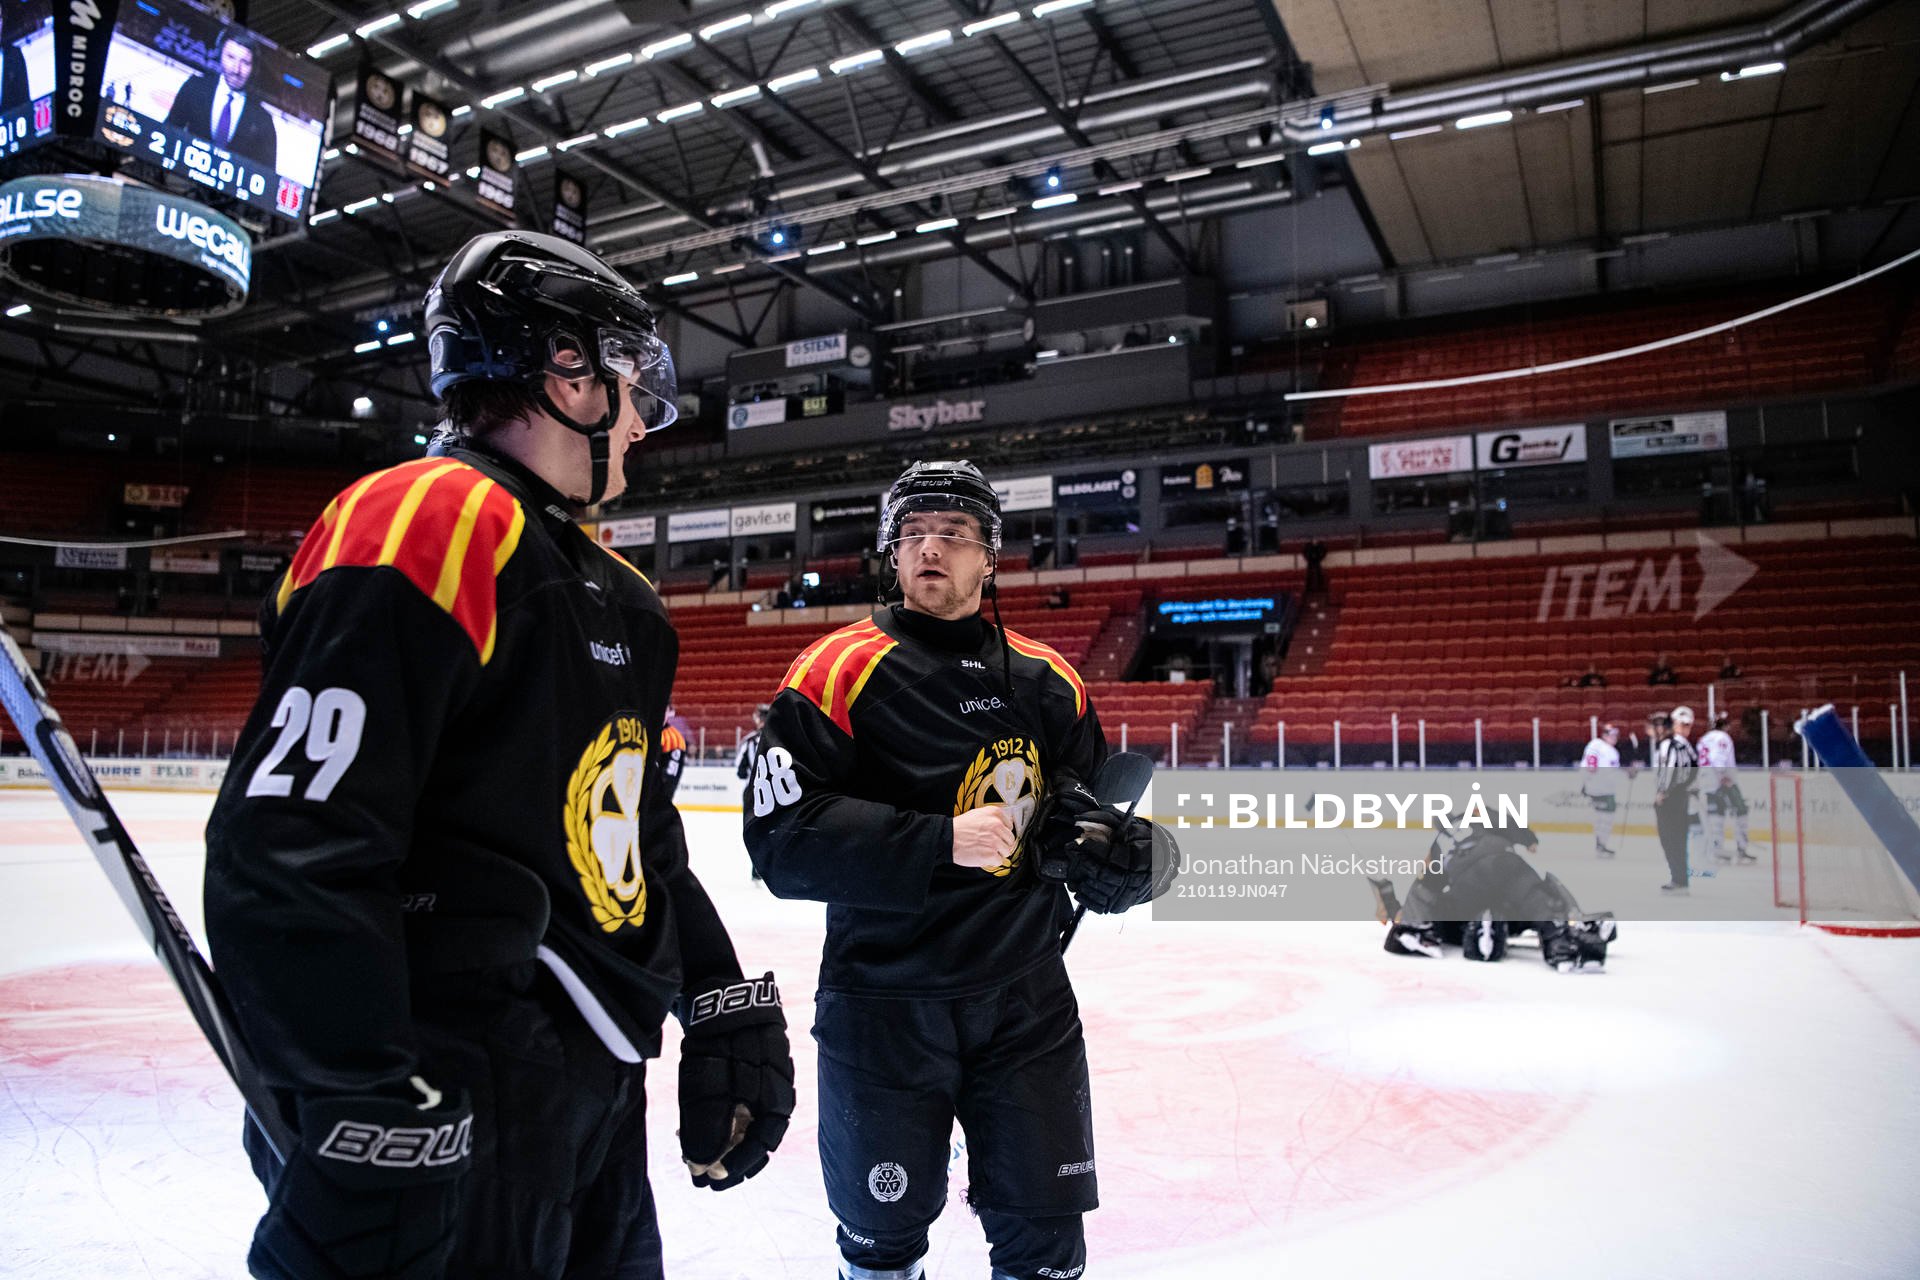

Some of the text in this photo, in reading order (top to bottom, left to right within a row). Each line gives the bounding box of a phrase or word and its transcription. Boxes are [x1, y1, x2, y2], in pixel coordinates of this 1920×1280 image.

[67, 35, 87, 117] MIDROC
[149, 131, 166, 154] 2
[250, 173, 266, 195] 0
[803, 338, 840, 354] STENA
[888, 401, 986, 431] Skybar
[734, 508, 792, 532] gavle.se
[1536, 553, 1682, 624] ITEM
[590, 640, 626, 666] unicef
[960, 659, 986, 669] SHL
[959, 697, 1007, 714] unice
[617, 717, 643, 744] 1912
[246, 687, 367, 802] 29
[992, 738, 1024, 759] 1912
[753, 746, 803, 818] 88
